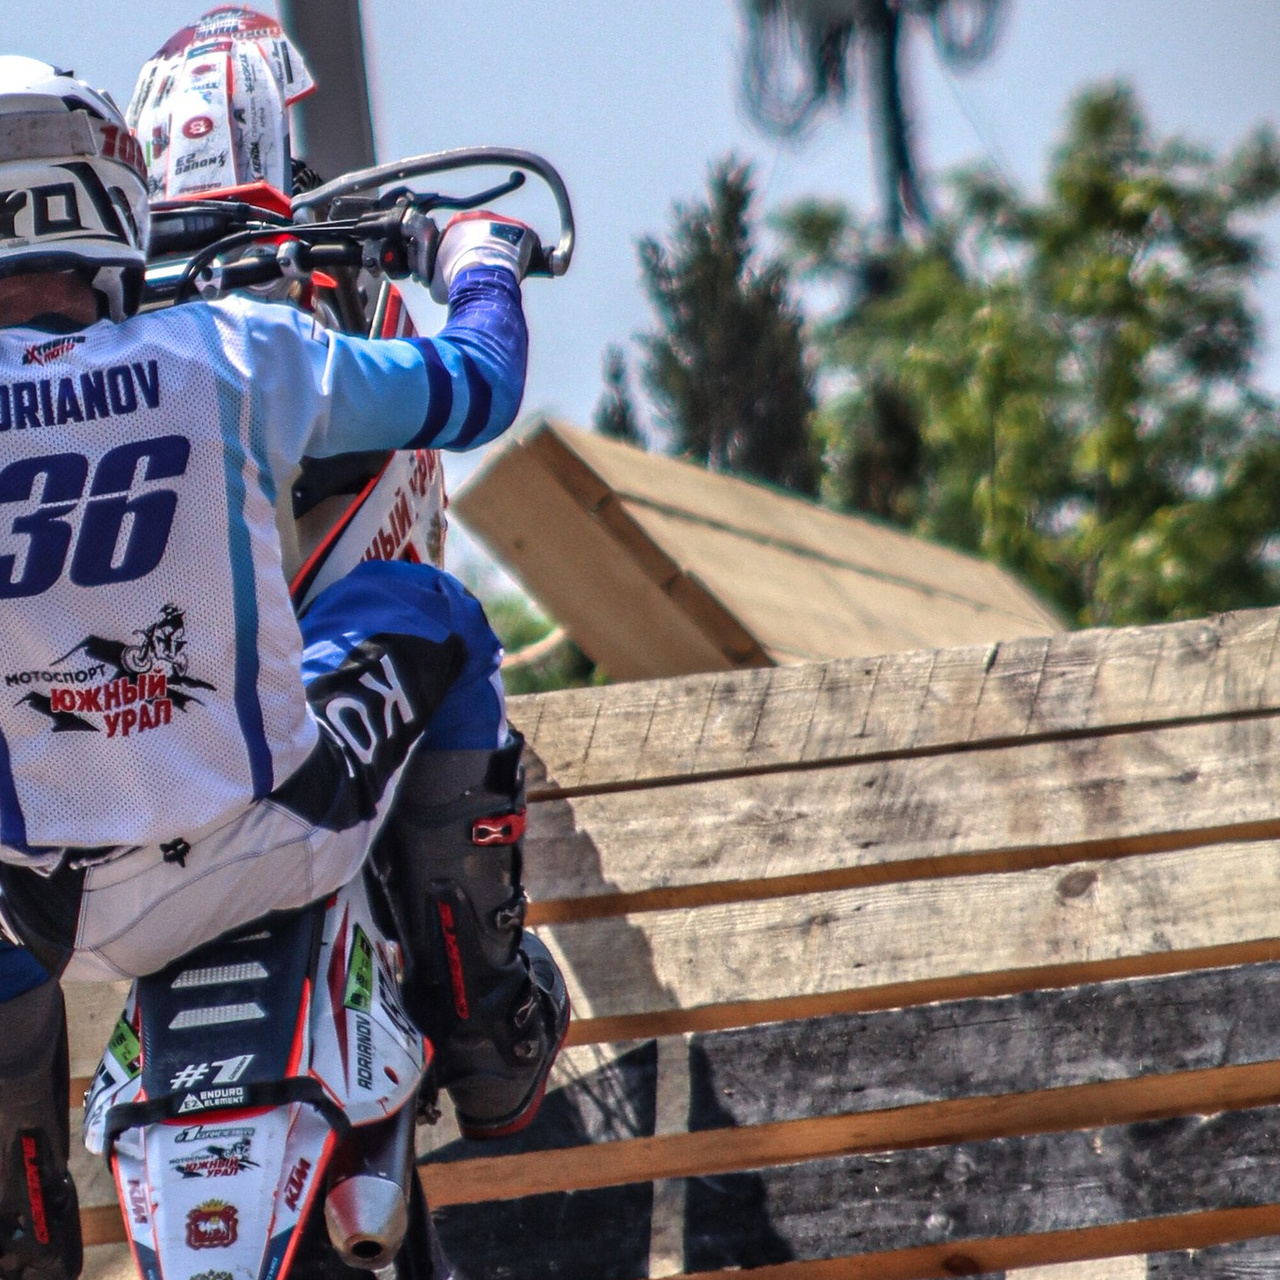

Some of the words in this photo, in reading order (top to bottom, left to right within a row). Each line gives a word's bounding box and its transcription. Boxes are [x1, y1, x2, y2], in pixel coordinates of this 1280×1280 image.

[175, 152, 197, 168] 23
[250, 141, 263, 174] KENDA
[4, 664, 106, 687] МОТОСПОРТ
[50, 668, 168, 713] ЮЖНЫЙ
[103, 698, 173, 739] УРАЛ
[355, 1013, 373, 1091] ADRIANOV
[170, 1053, 256, 1090] #1
[199, 1086, 244, 1100] ENDURO
[204, 1095, 245, 1107] ELEMENT
[184, 1156, 239, 1172] ЮЖНЫЙ
[205, 1167, 239, 1179] УРАЛ
[284, 1157, 312, 1212] KTM
[126, 1178, 149, 1225] KTM
